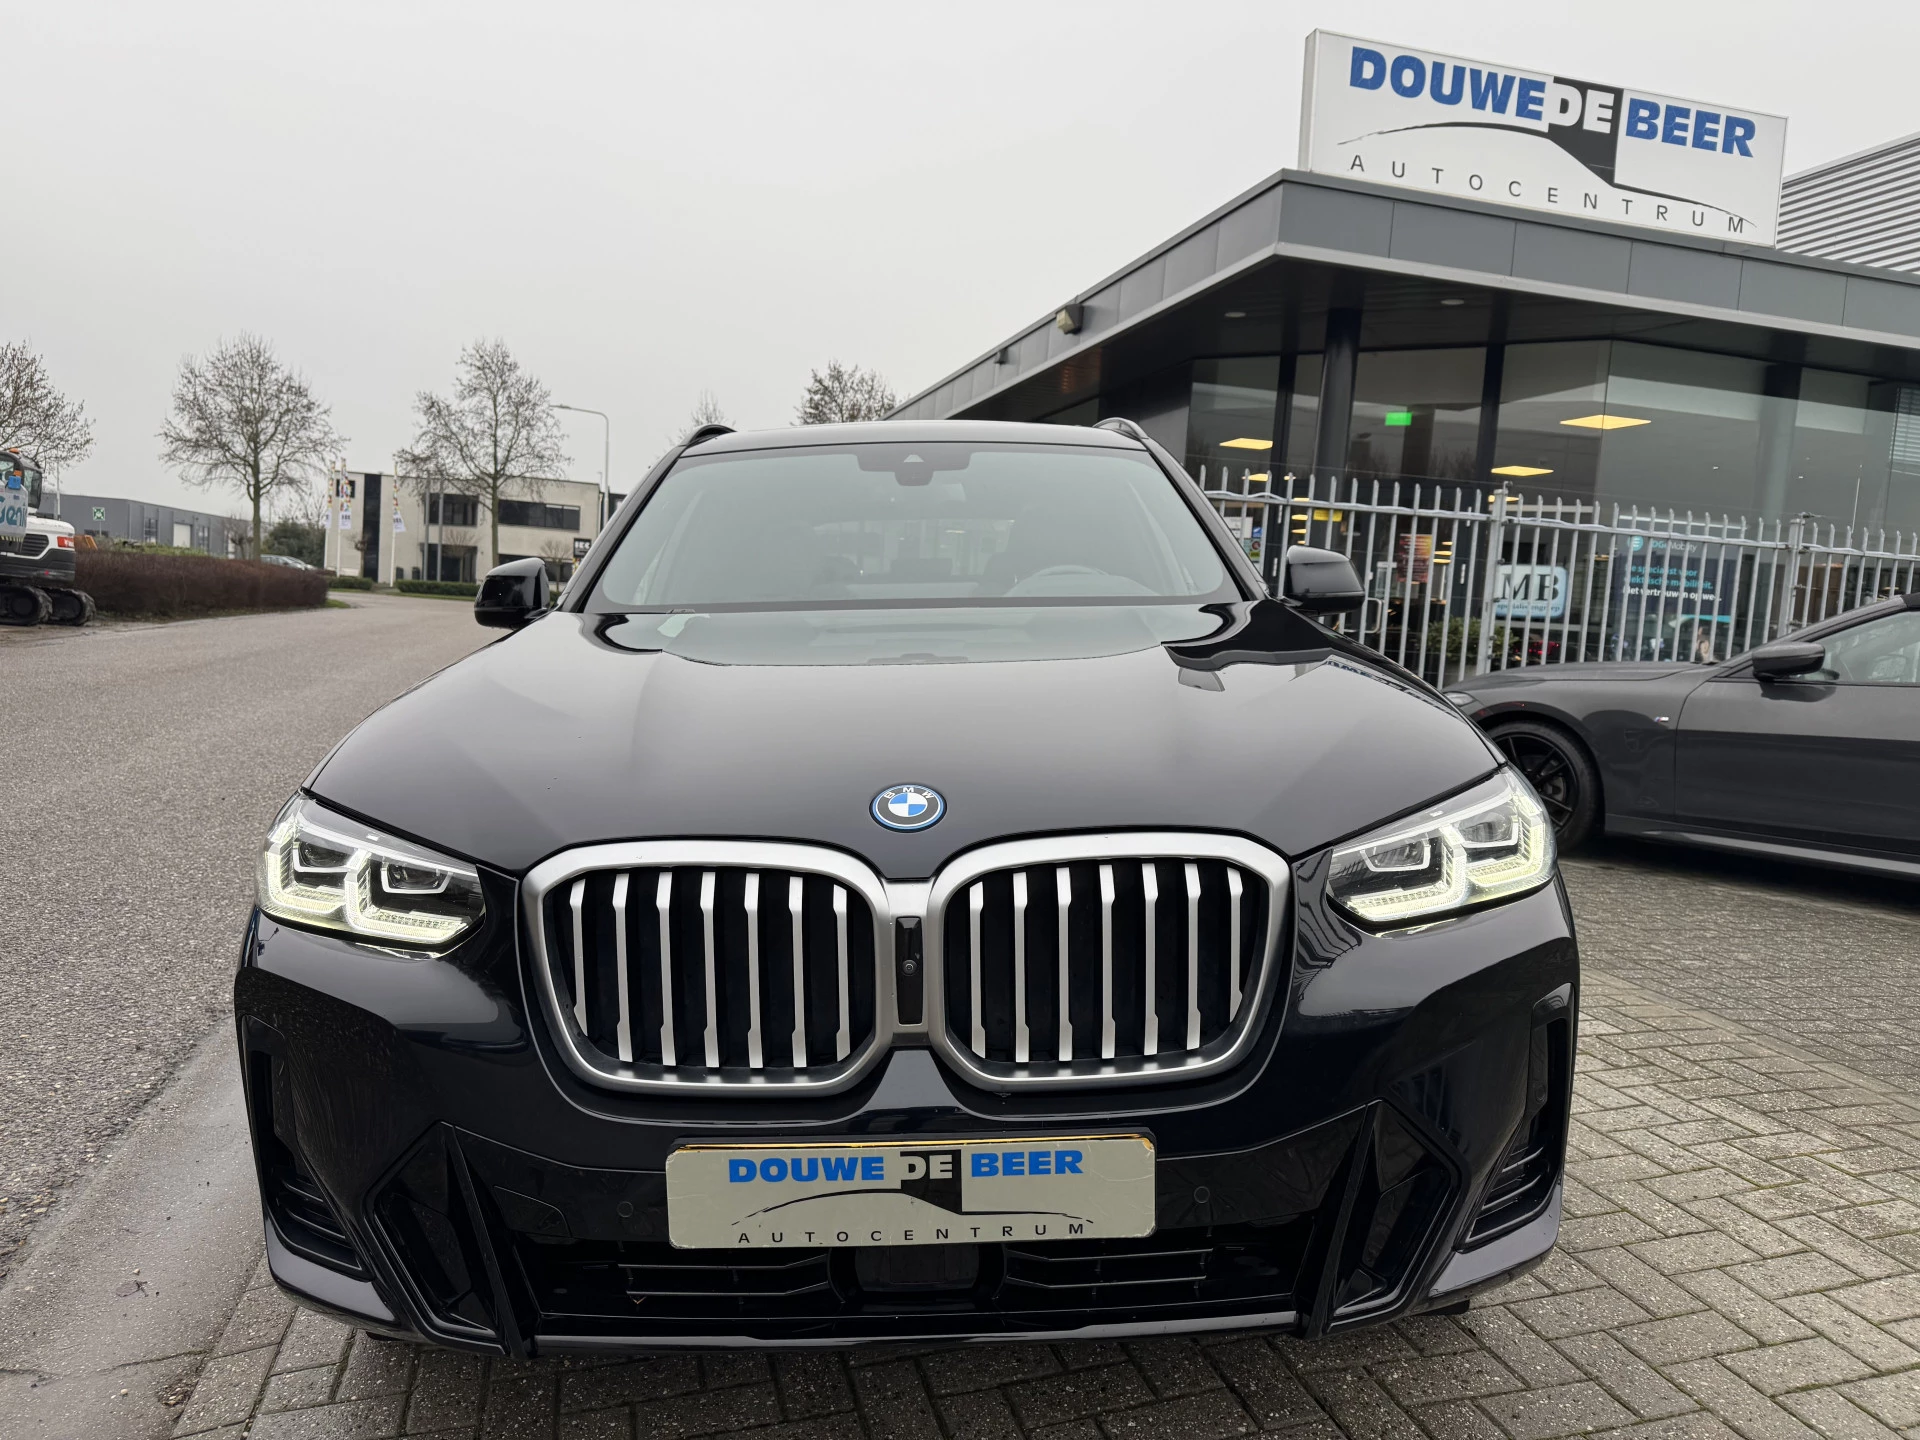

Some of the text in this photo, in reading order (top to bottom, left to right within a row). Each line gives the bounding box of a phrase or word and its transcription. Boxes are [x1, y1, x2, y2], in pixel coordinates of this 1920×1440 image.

[1349, 46, 1756, 158] DOUWE DE BEER
[1349, 154, 1744, 234] AUTOCENTRUM
[1501, 573, 1559, 601] MB
[883, 787, 935, 799] BMW
[728, 1149, 1084, 1183] DOUWE DE BEER
[738, 1223, 1085, 1244] AUTOCENTRUM
